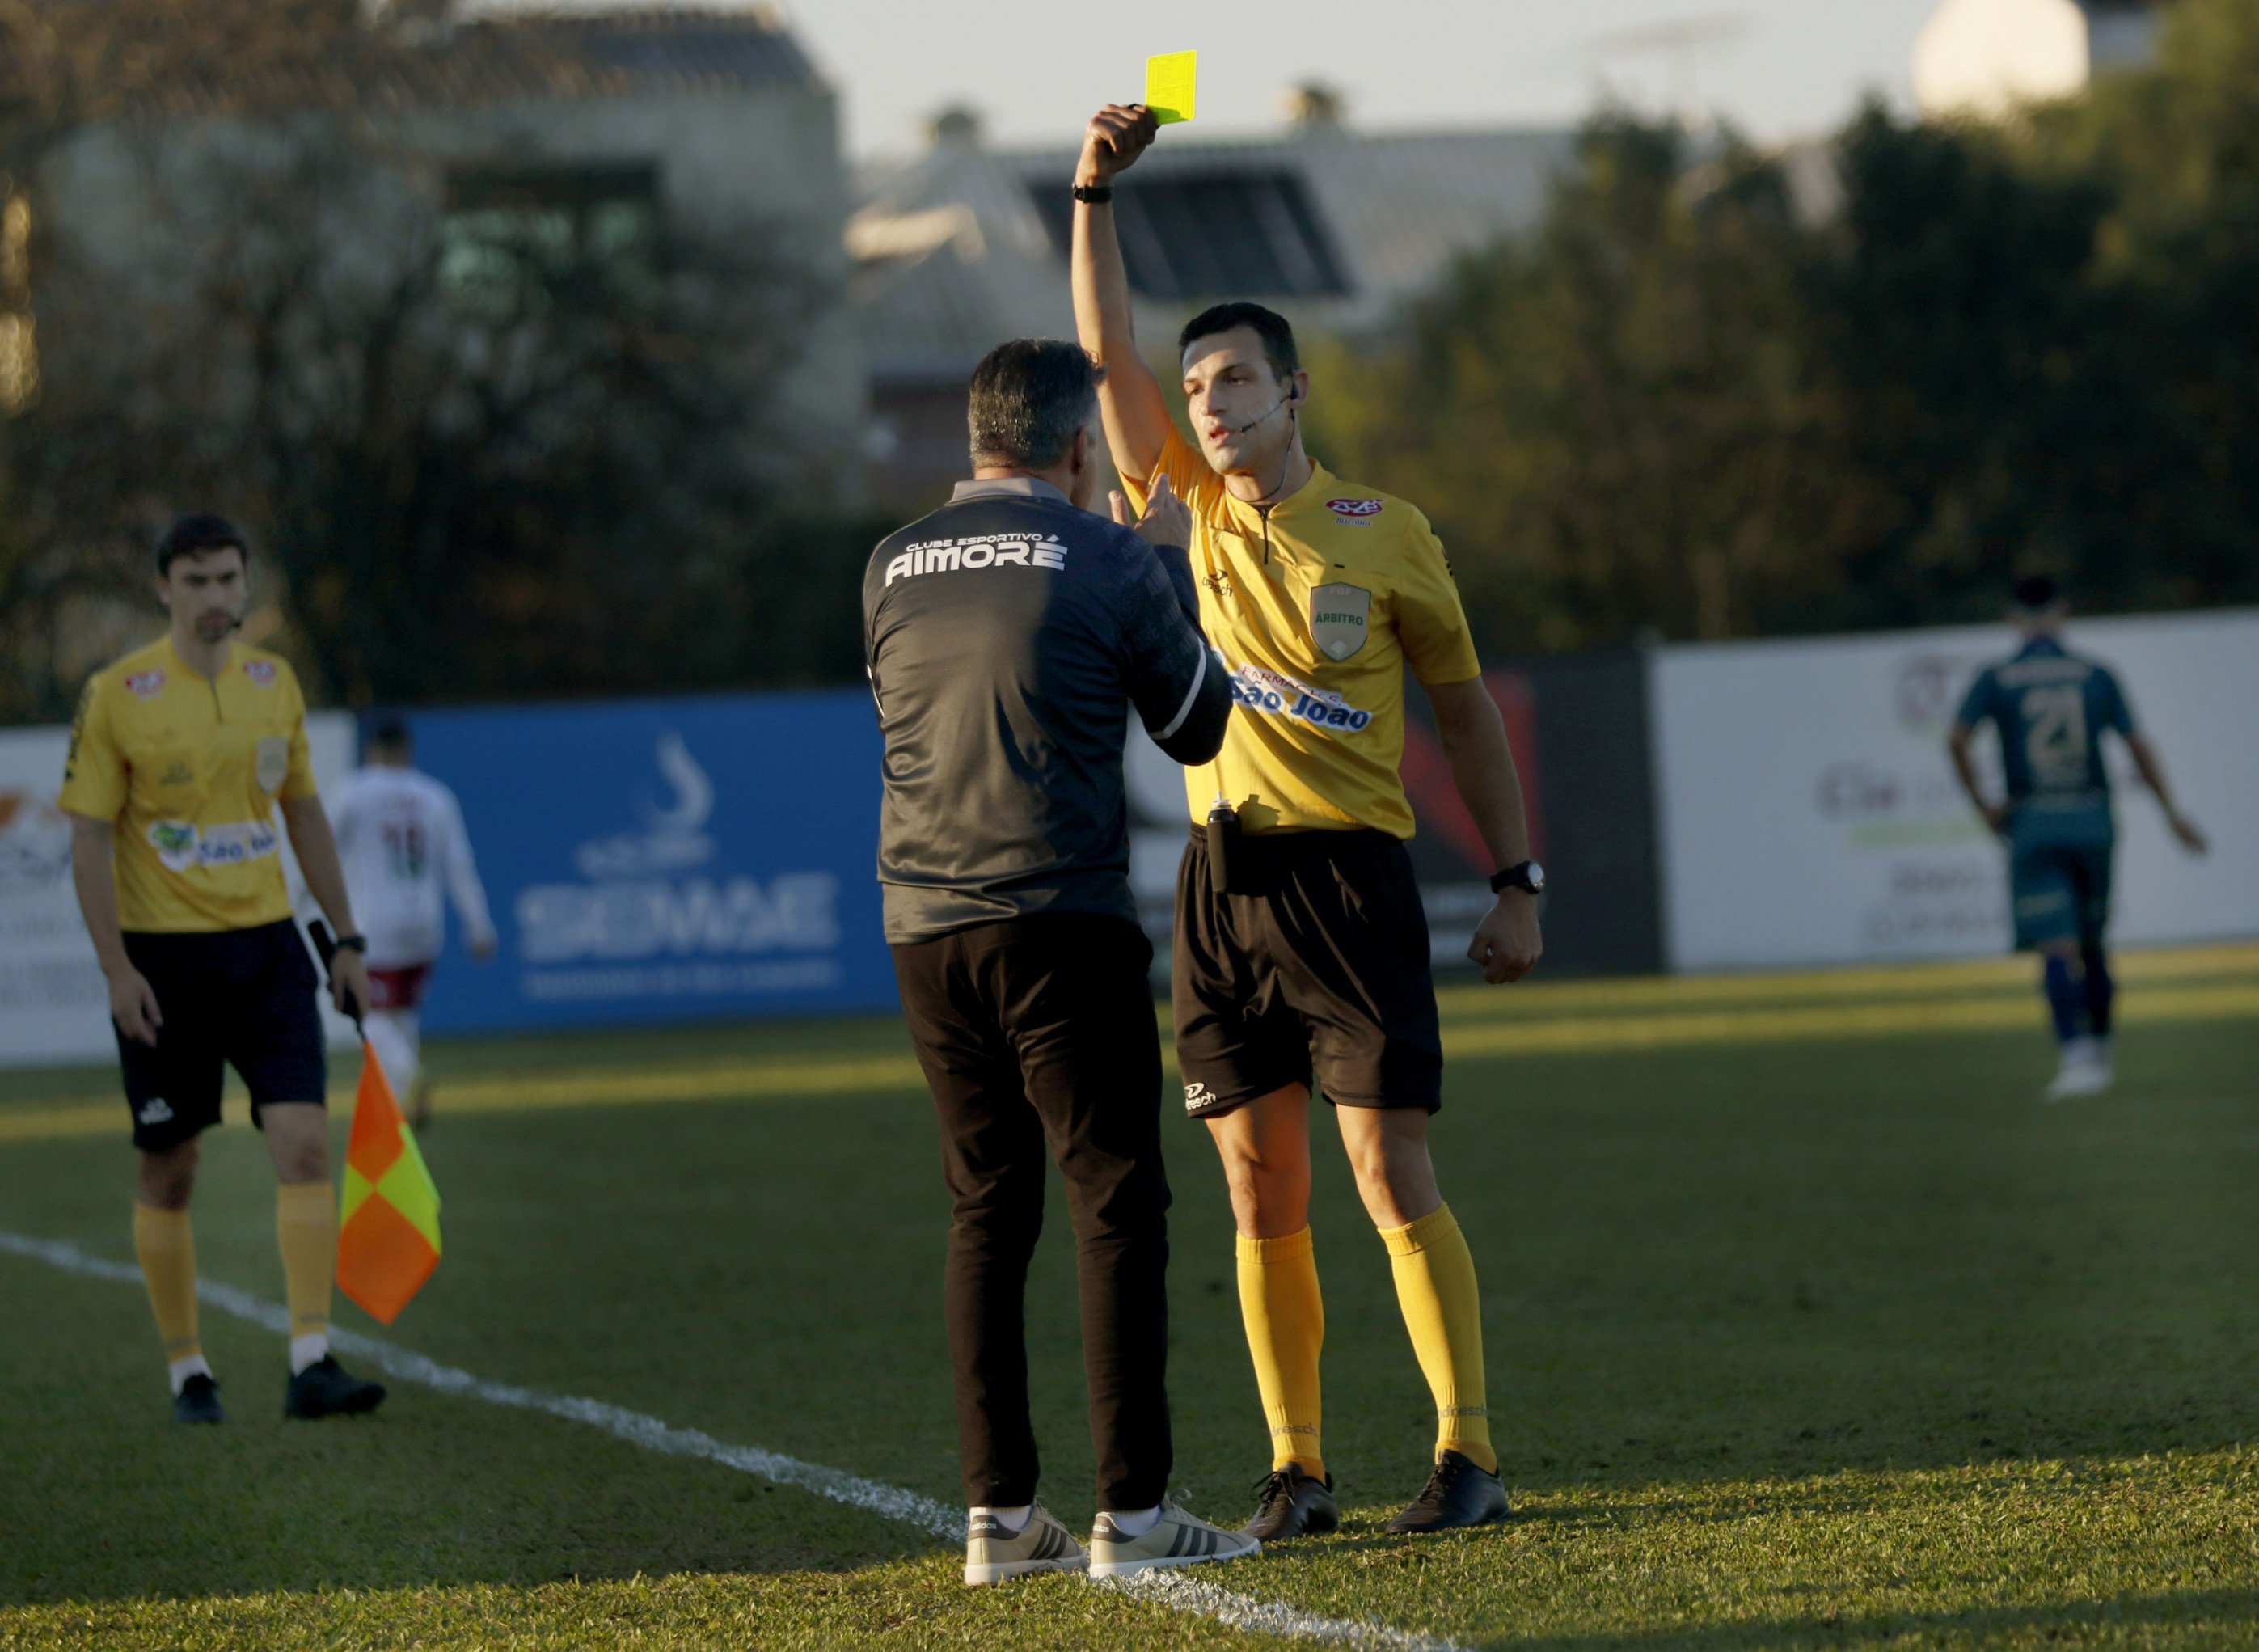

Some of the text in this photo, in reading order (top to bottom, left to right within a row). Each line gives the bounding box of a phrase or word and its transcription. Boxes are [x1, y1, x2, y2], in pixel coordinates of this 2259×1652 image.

[885, 534, 1068, 588] AIMORÉ
[906, 532, 1043, 553] CLUBE ESPORTIVO
